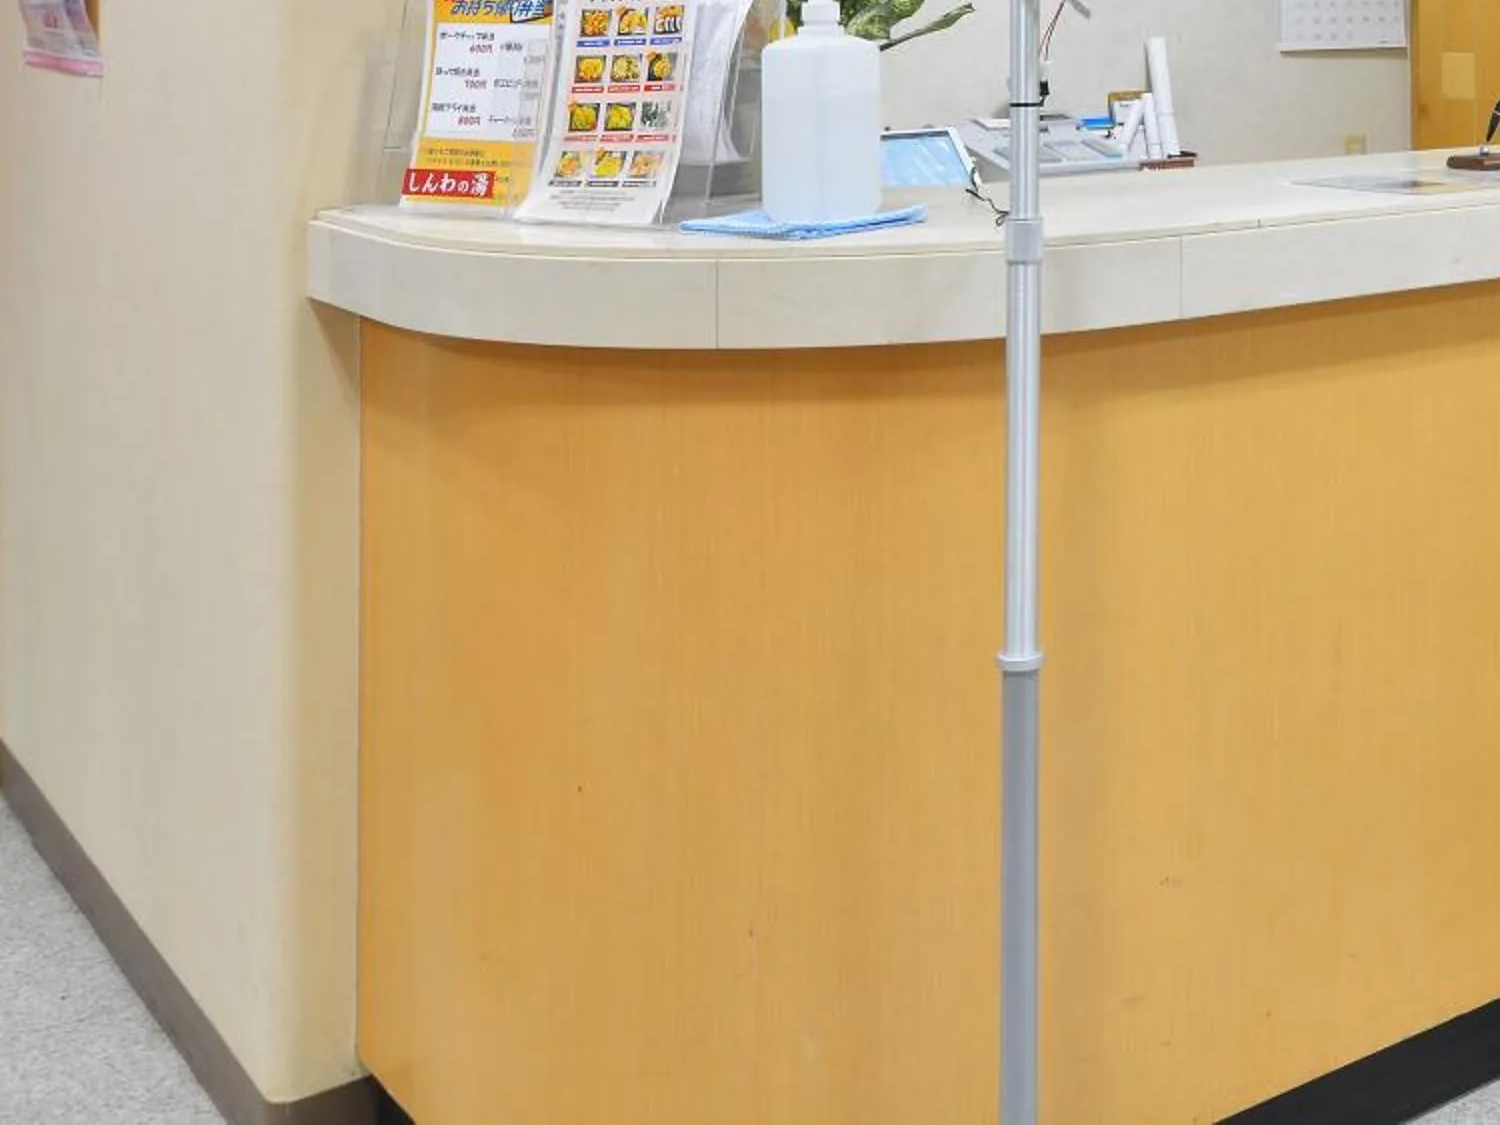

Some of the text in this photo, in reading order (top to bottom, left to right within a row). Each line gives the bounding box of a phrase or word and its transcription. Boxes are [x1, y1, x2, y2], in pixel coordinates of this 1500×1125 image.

[409, 172, 489, 196] しんわの湯
